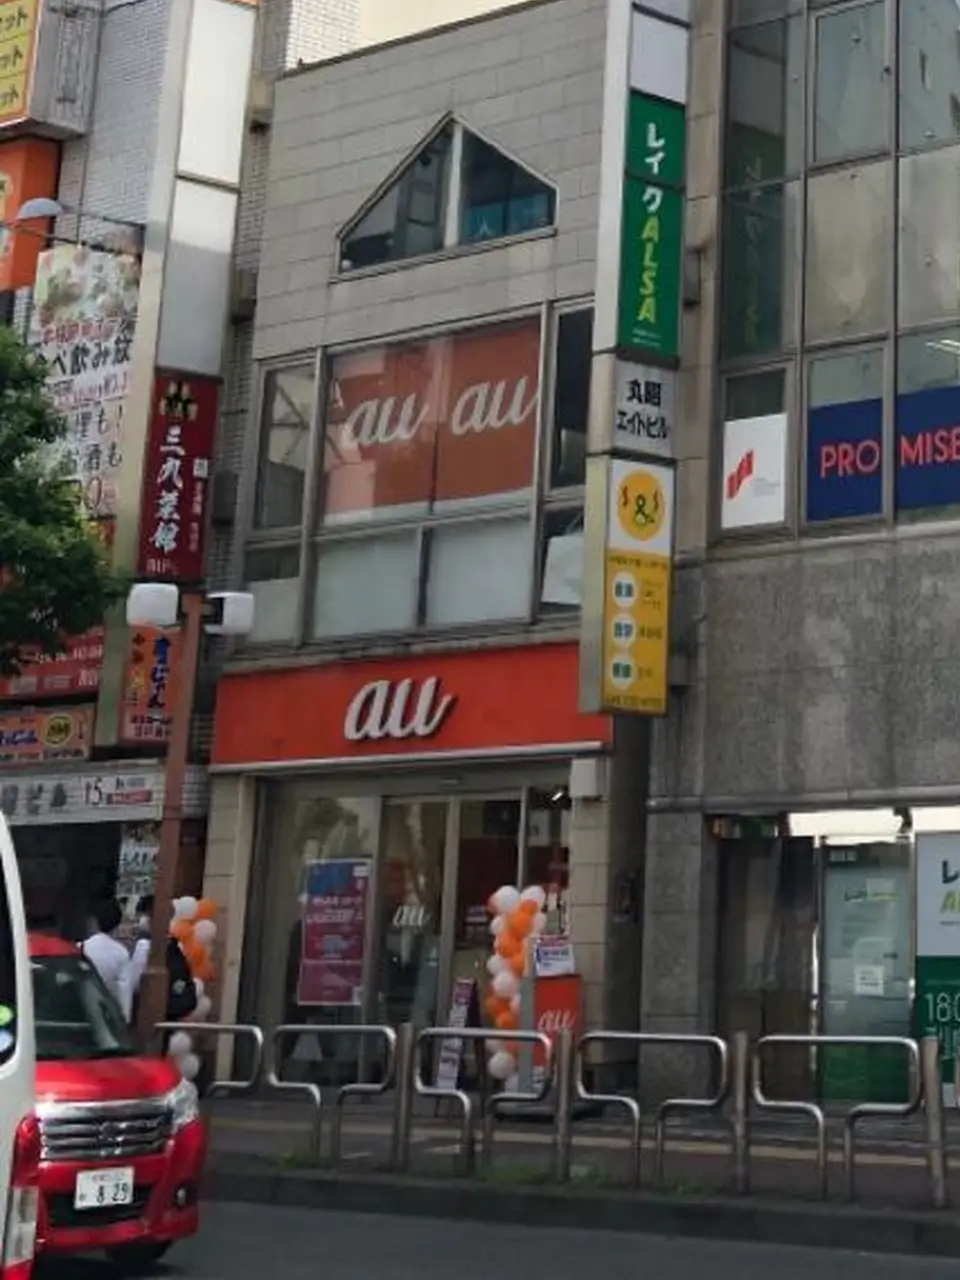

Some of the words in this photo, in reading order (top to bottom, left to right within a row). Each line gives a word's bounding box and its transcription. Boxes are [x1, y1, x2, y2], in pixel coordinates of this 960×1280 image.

[344, 391, 431, 448] au
[452, 375, 541, 436] au
[617, 409, 668, 439] エイトビル
[344, 675, 454, 741] au
